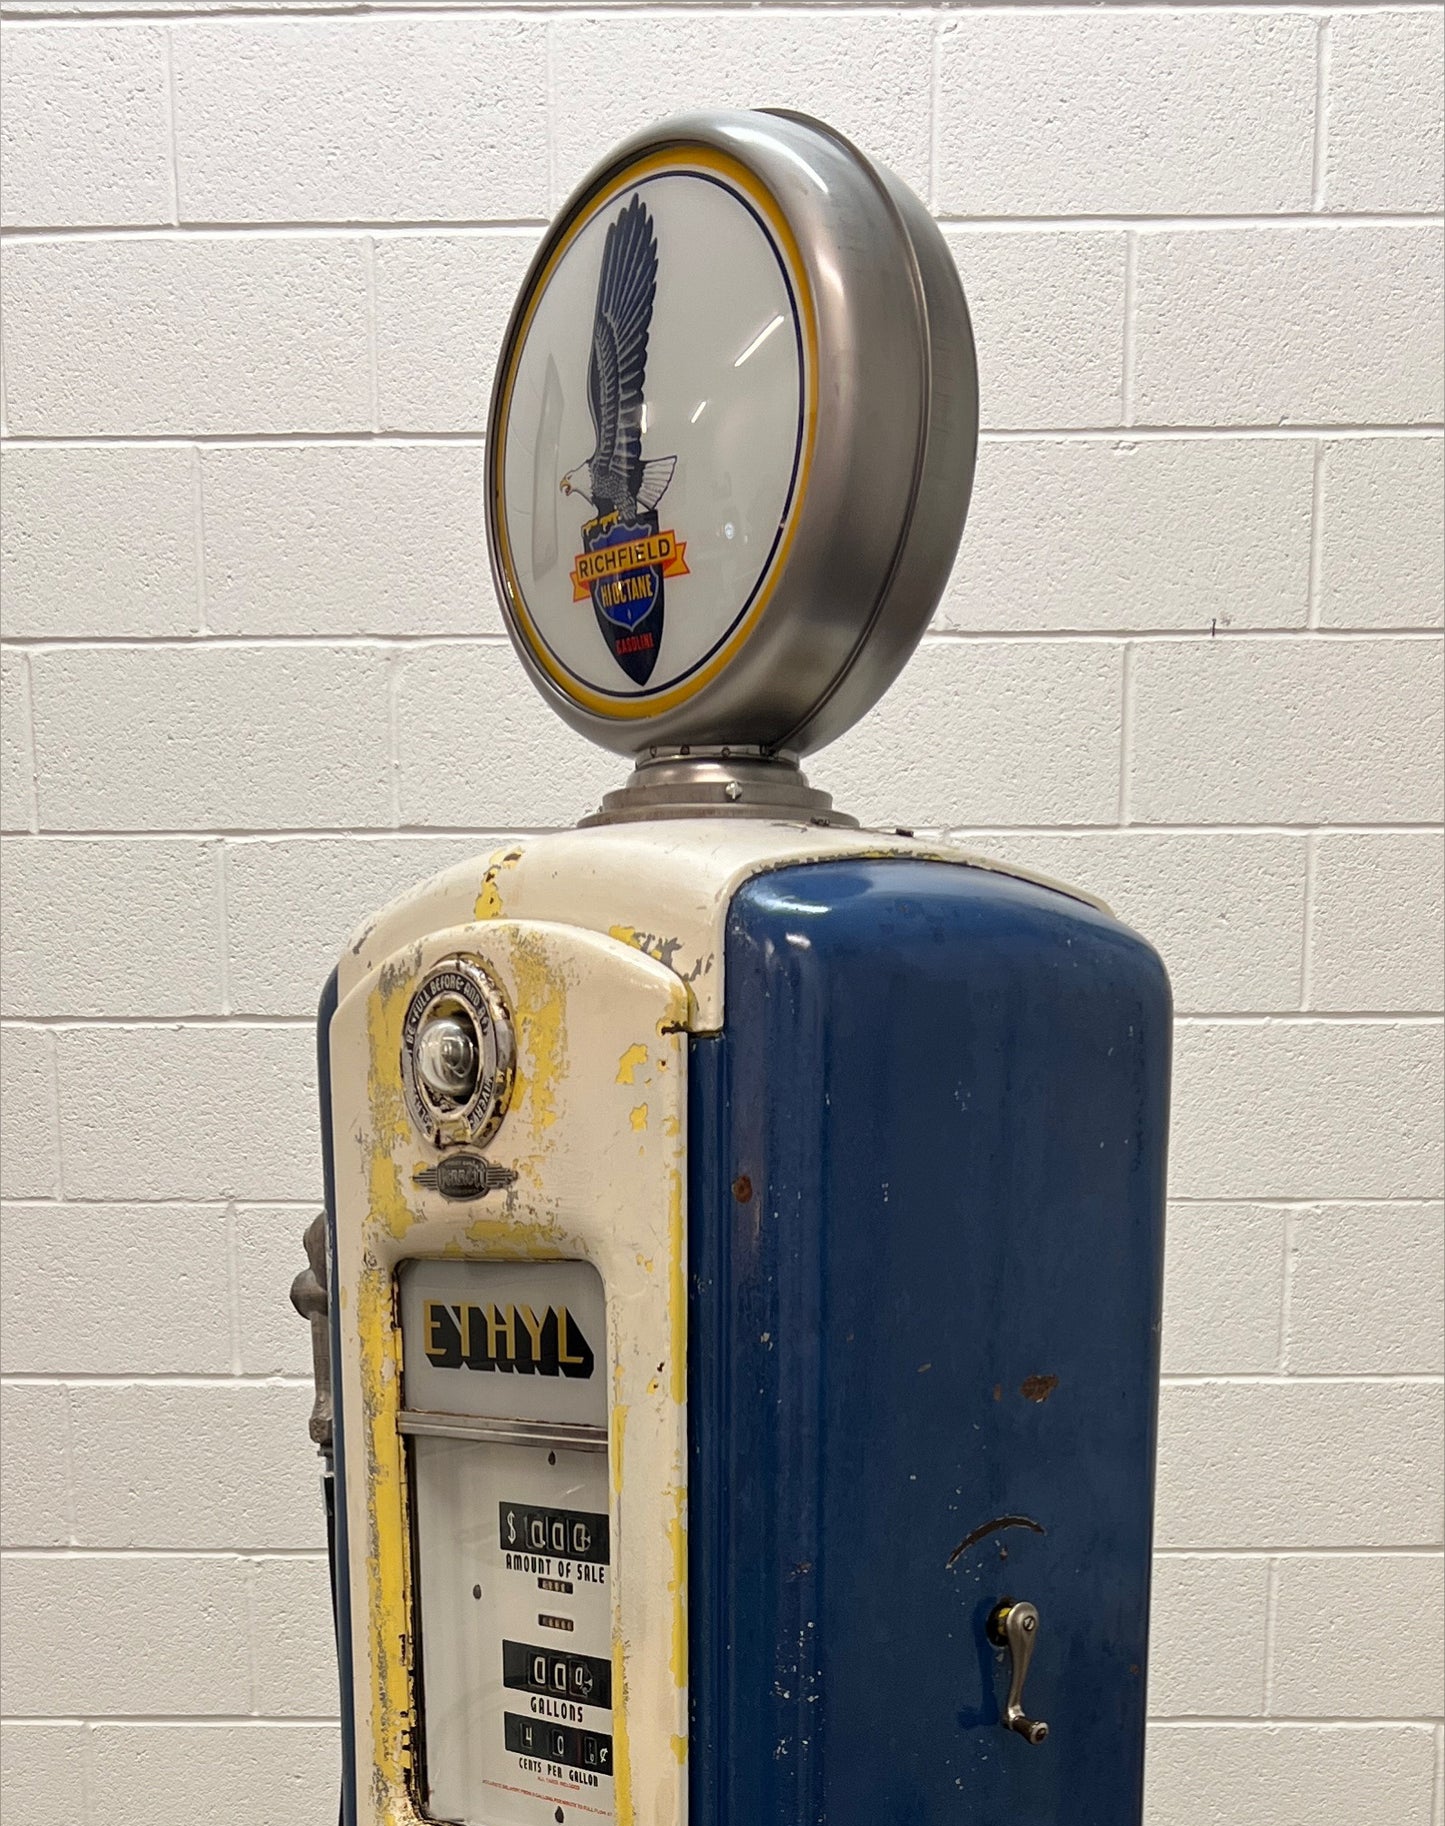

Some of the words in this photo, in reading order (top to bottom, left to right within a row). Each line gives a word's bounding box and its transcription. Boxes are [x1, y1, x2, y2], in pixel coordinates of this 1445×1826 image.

[579, 538, 671, 578] RICHFIELD
[412, 989, 431, 1020] FULL
[430, 974, 463, 996] BEFORE
[463, 981, 480, 1006] AND
[423, 1299, 594, 1379] ETHYL
[505, 1553, 552, 1575] AMOUNT
[558, 1560, 572, 1579] OF
[577, 1563, 605, 1584] SALE
[530, 1696, 584, 1723] GALLONS
[518, 1757, 542, 1773] CENTS
[547, 1763, 563, 1779] PER
[568, 1769, 599, 1787] GALLON
